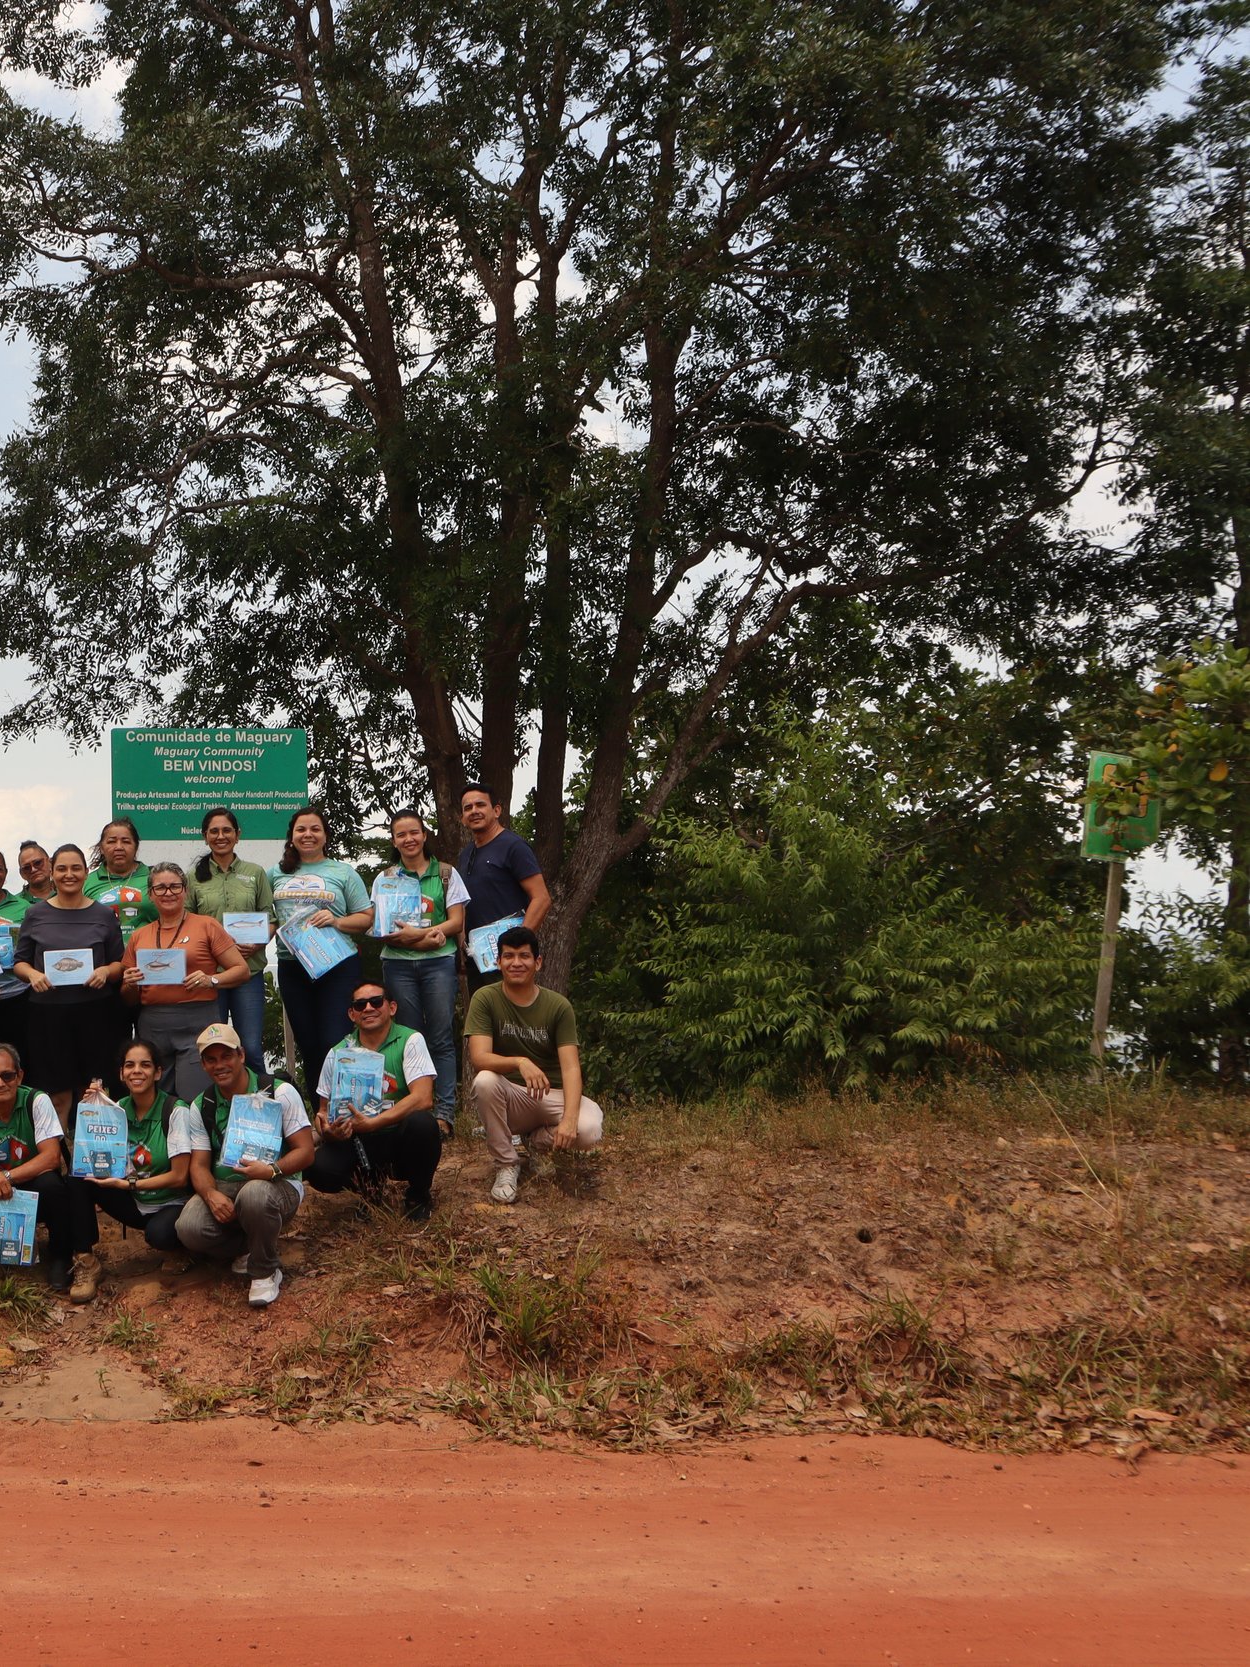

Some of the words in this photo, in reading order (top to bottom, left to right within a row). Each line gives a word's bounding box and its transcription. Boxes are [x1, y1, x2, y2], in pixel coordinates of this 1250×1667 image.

[126, 730, 211, 742] Comunidade
[215, 731, 231, 742] de
[235, 731, 293, 745] Maguary
[154, 747, 200, 758] Maguary
[203, 746, 265, 758] Community
[163, 760, 194, 771] BEM
[198, 760, 256, 771] VINDOS!
[184, 774, 235, 783] welcome!
[116, 791, 147, 800] Produção
[171, 802, 201, 811] Ecological
[88, 1124, 117, 1135] PEIXES
